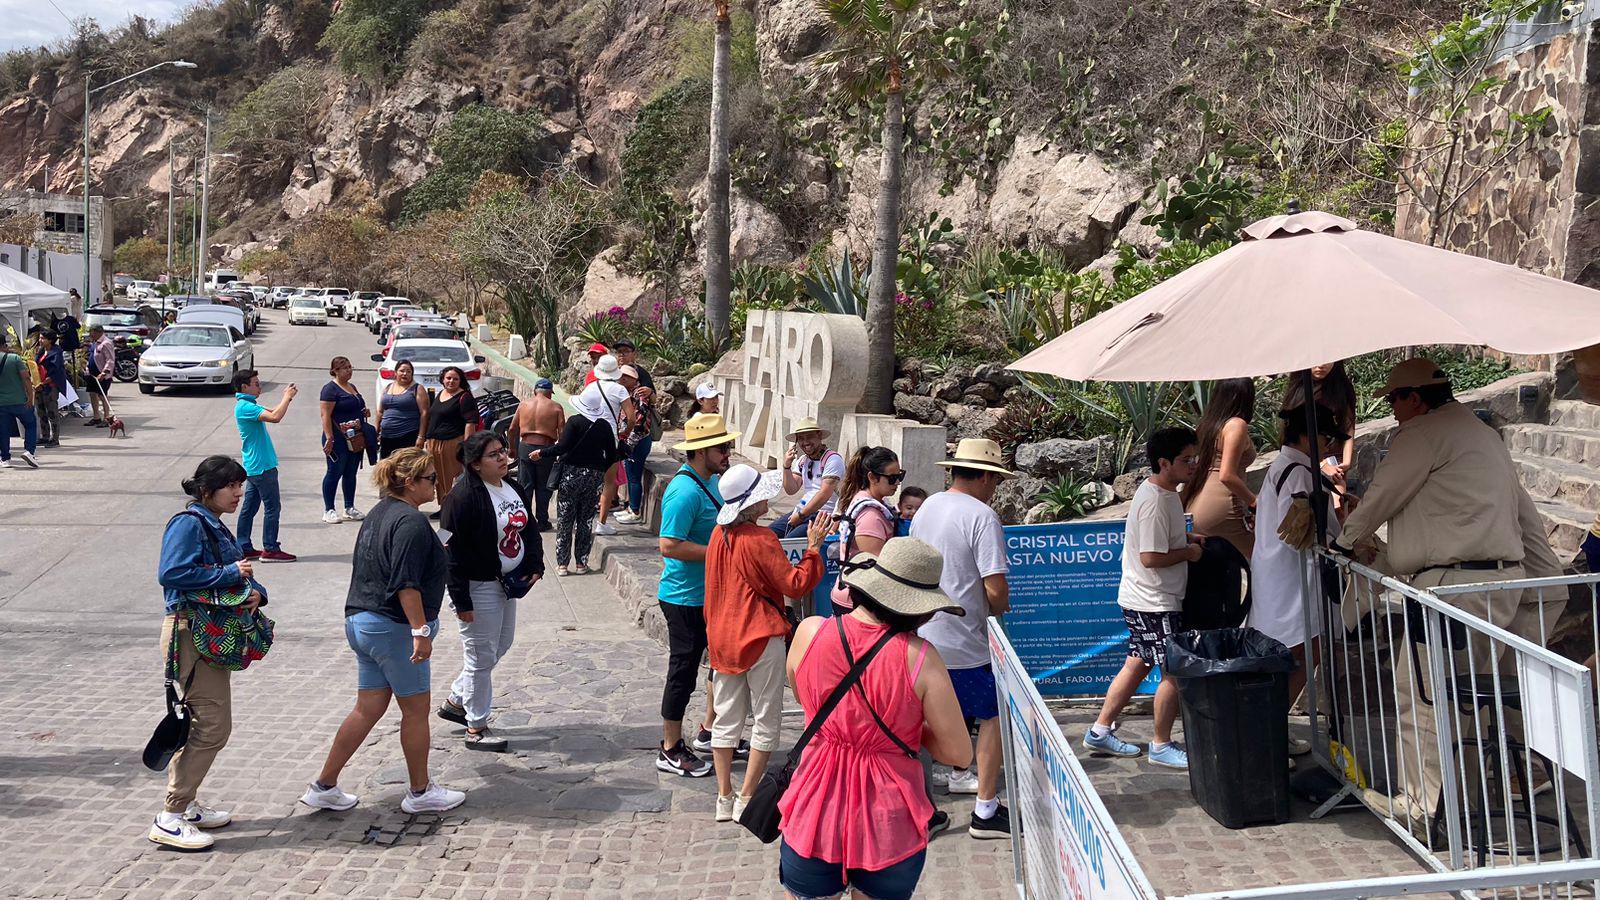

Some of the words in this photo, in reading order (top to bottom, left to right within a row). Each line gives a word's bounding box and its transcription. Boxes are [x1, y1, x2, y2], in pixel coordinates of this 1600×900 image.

[744, 309, 833, 404] FARO
[1006, 534, 1079, 549] CRISTAL
[1050, 549, 1113, 564] NUEVO
[1032, 677, 1063, 685] TURAL
[1065, 675, 1093, 684] FARO
[1033, 718, 1106, 891] BIENVENIDOS
